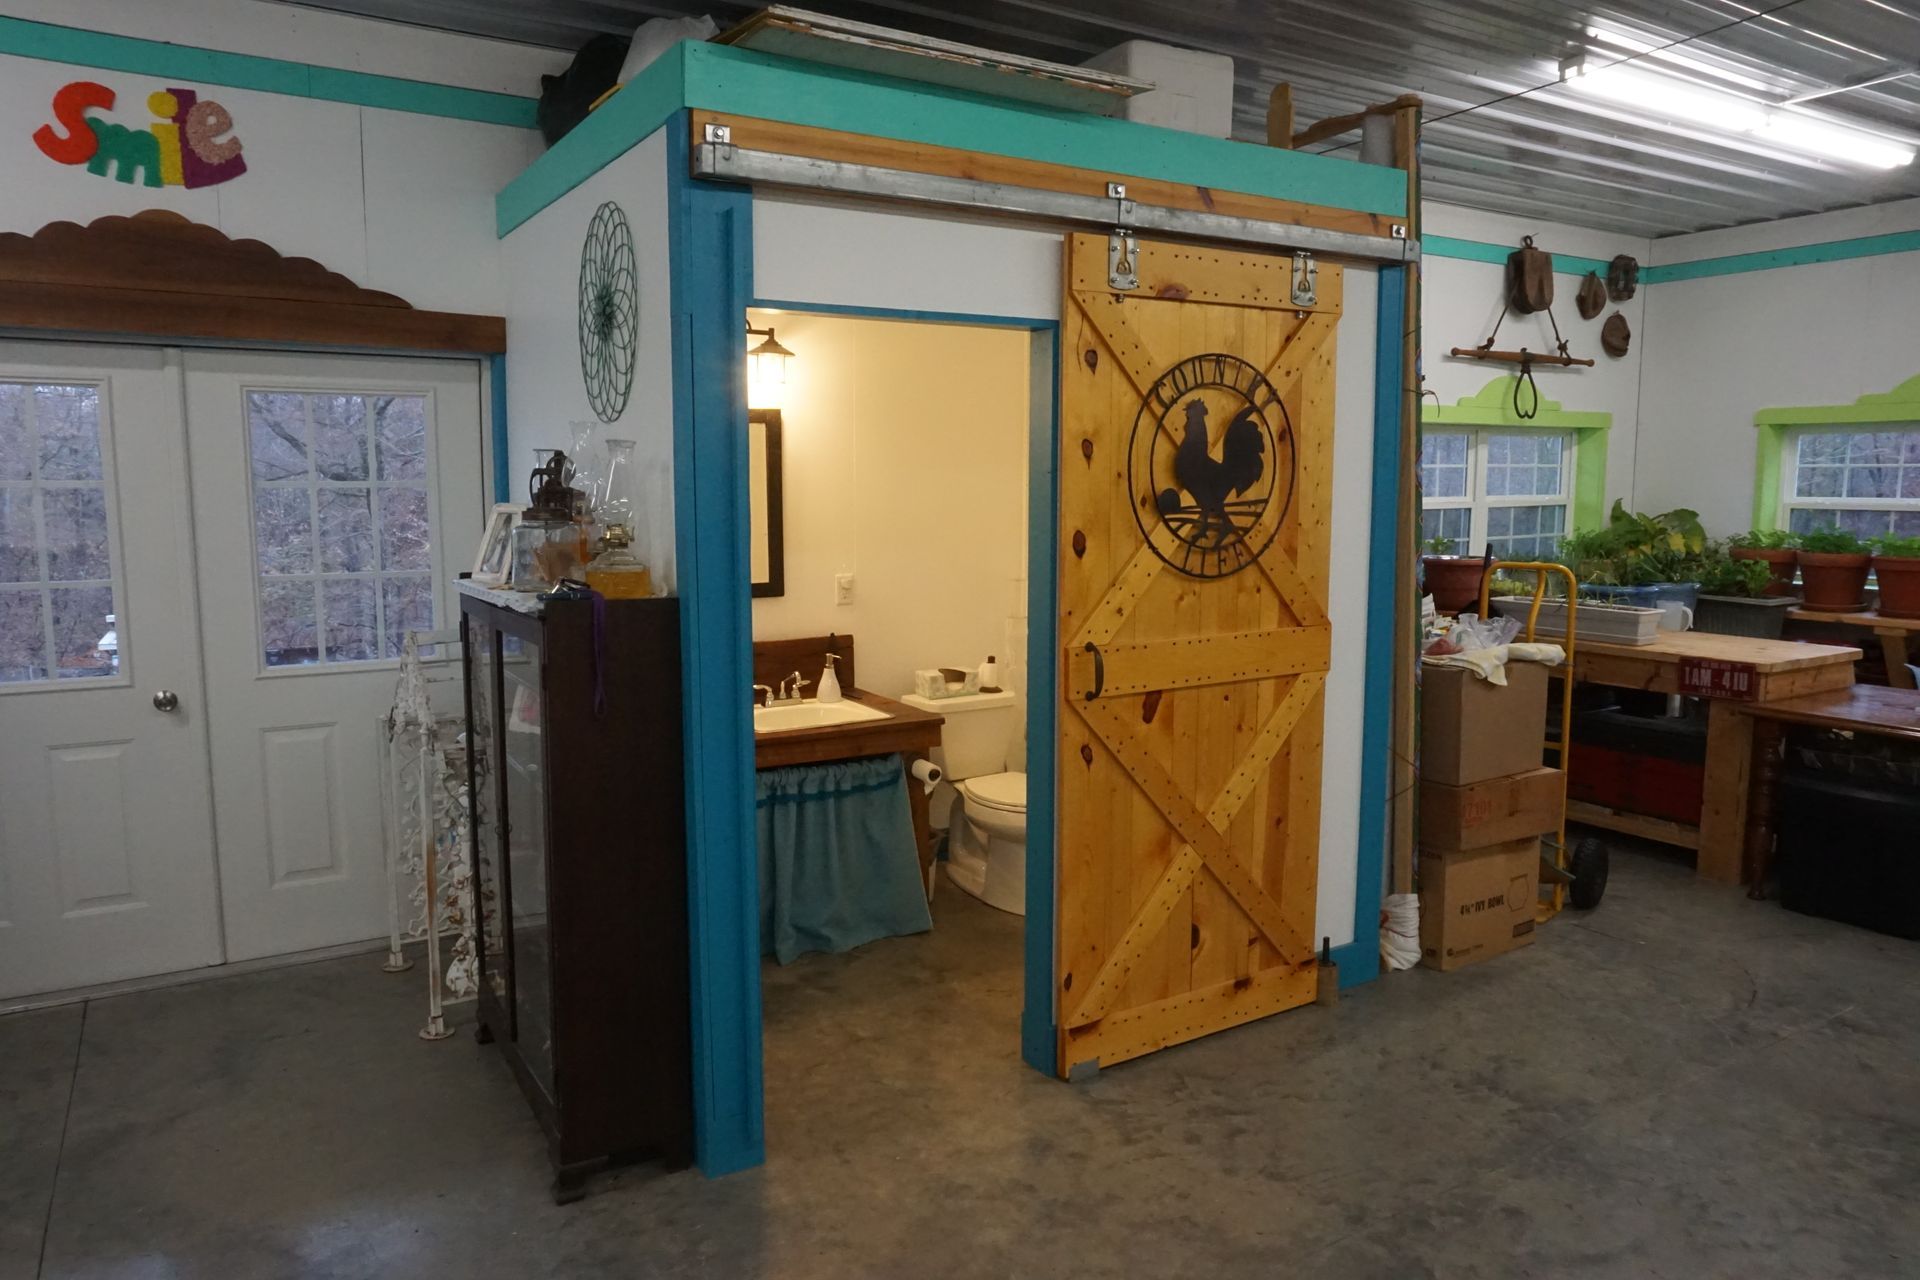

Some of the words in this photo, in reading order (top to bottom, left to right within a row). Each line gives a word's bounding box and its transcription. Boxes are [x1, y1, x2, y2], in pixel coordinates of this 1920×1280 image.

[1154, 354, 1279, 409] COUNTRY
[1182, 544, 1245, 577] LIFE
[1488, 895, 1504, 909] BOWL
